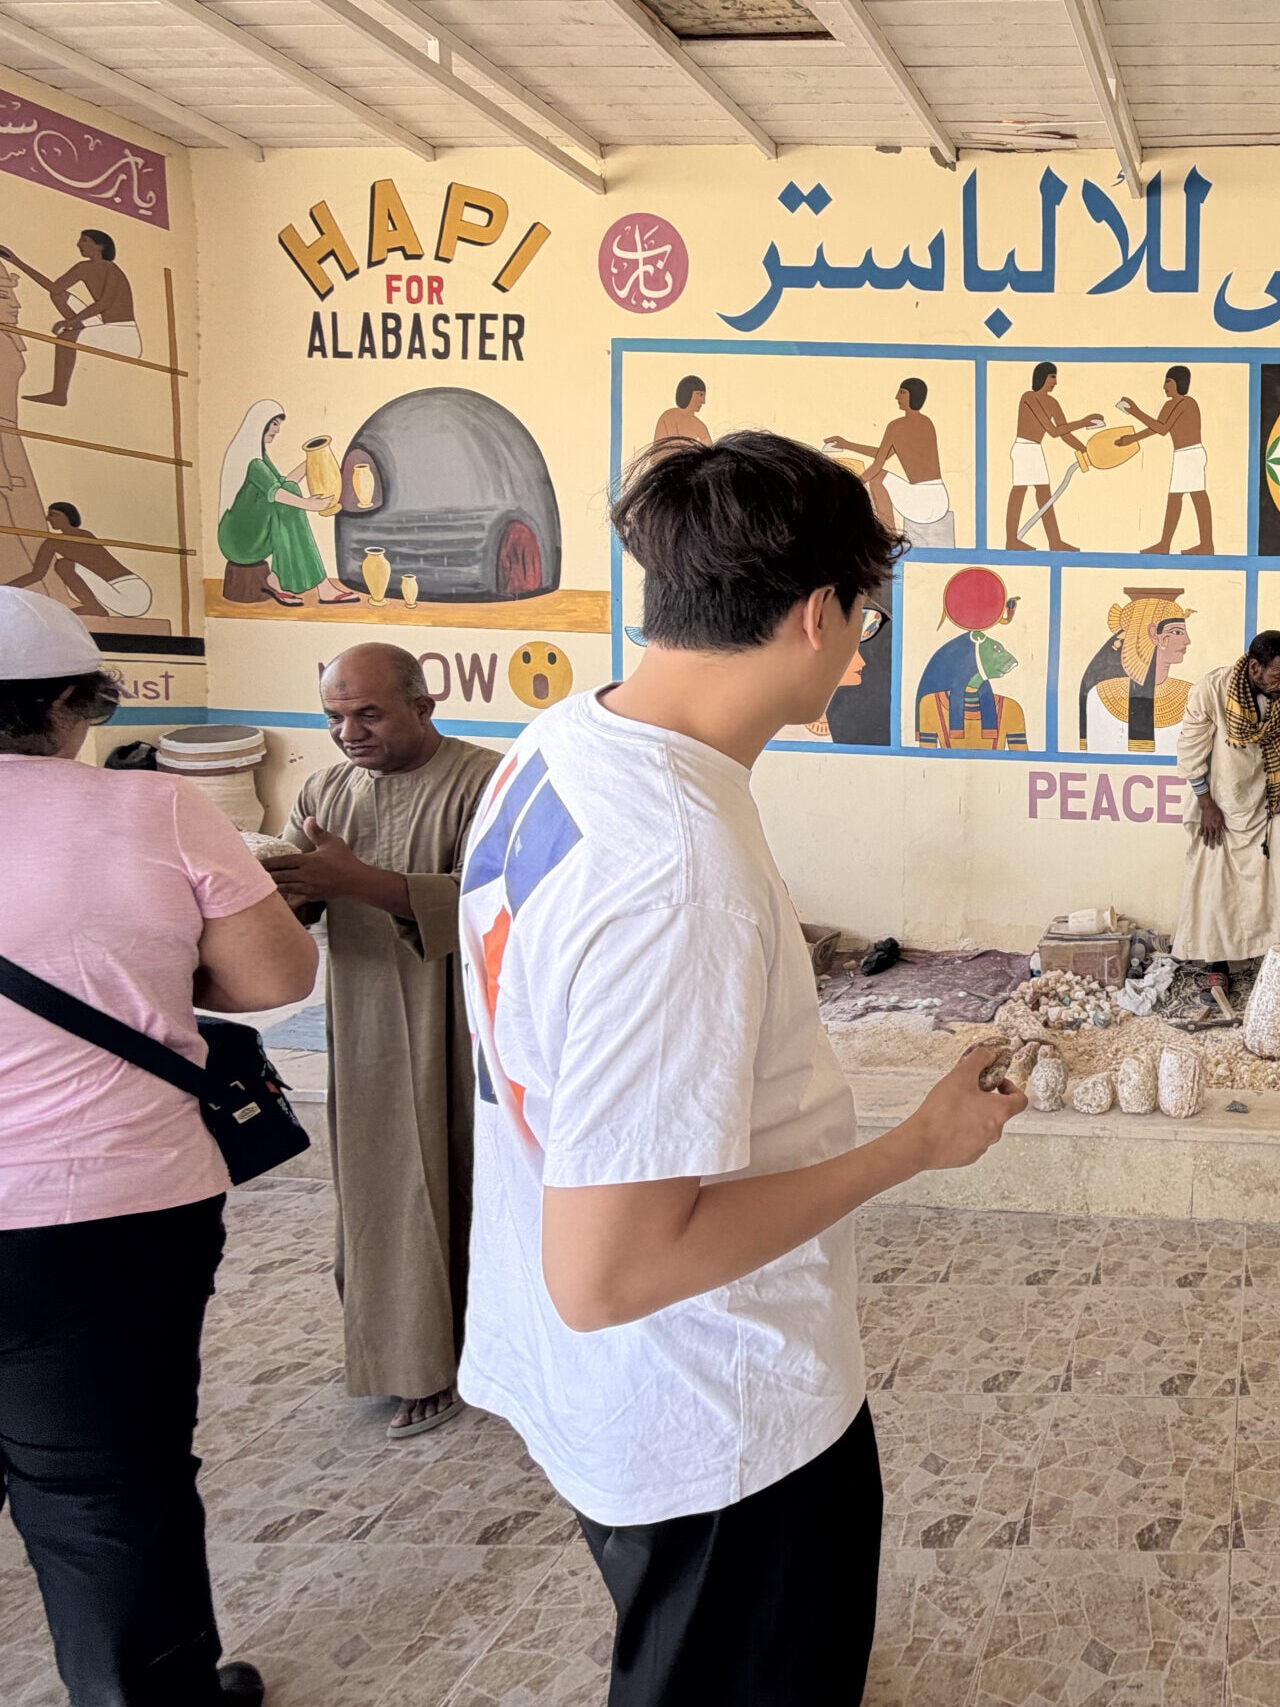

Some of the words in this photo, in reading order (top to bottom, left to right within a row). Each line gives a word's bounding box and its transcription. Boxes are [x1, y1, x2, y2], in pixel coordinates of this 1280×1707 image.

[278, 178, 552, 302] HAPI
[385, 273, 445, 306] FOR
[307, 310, 526, 362] ALABASTER
[1027, 770, 1188, 825] PEACE
